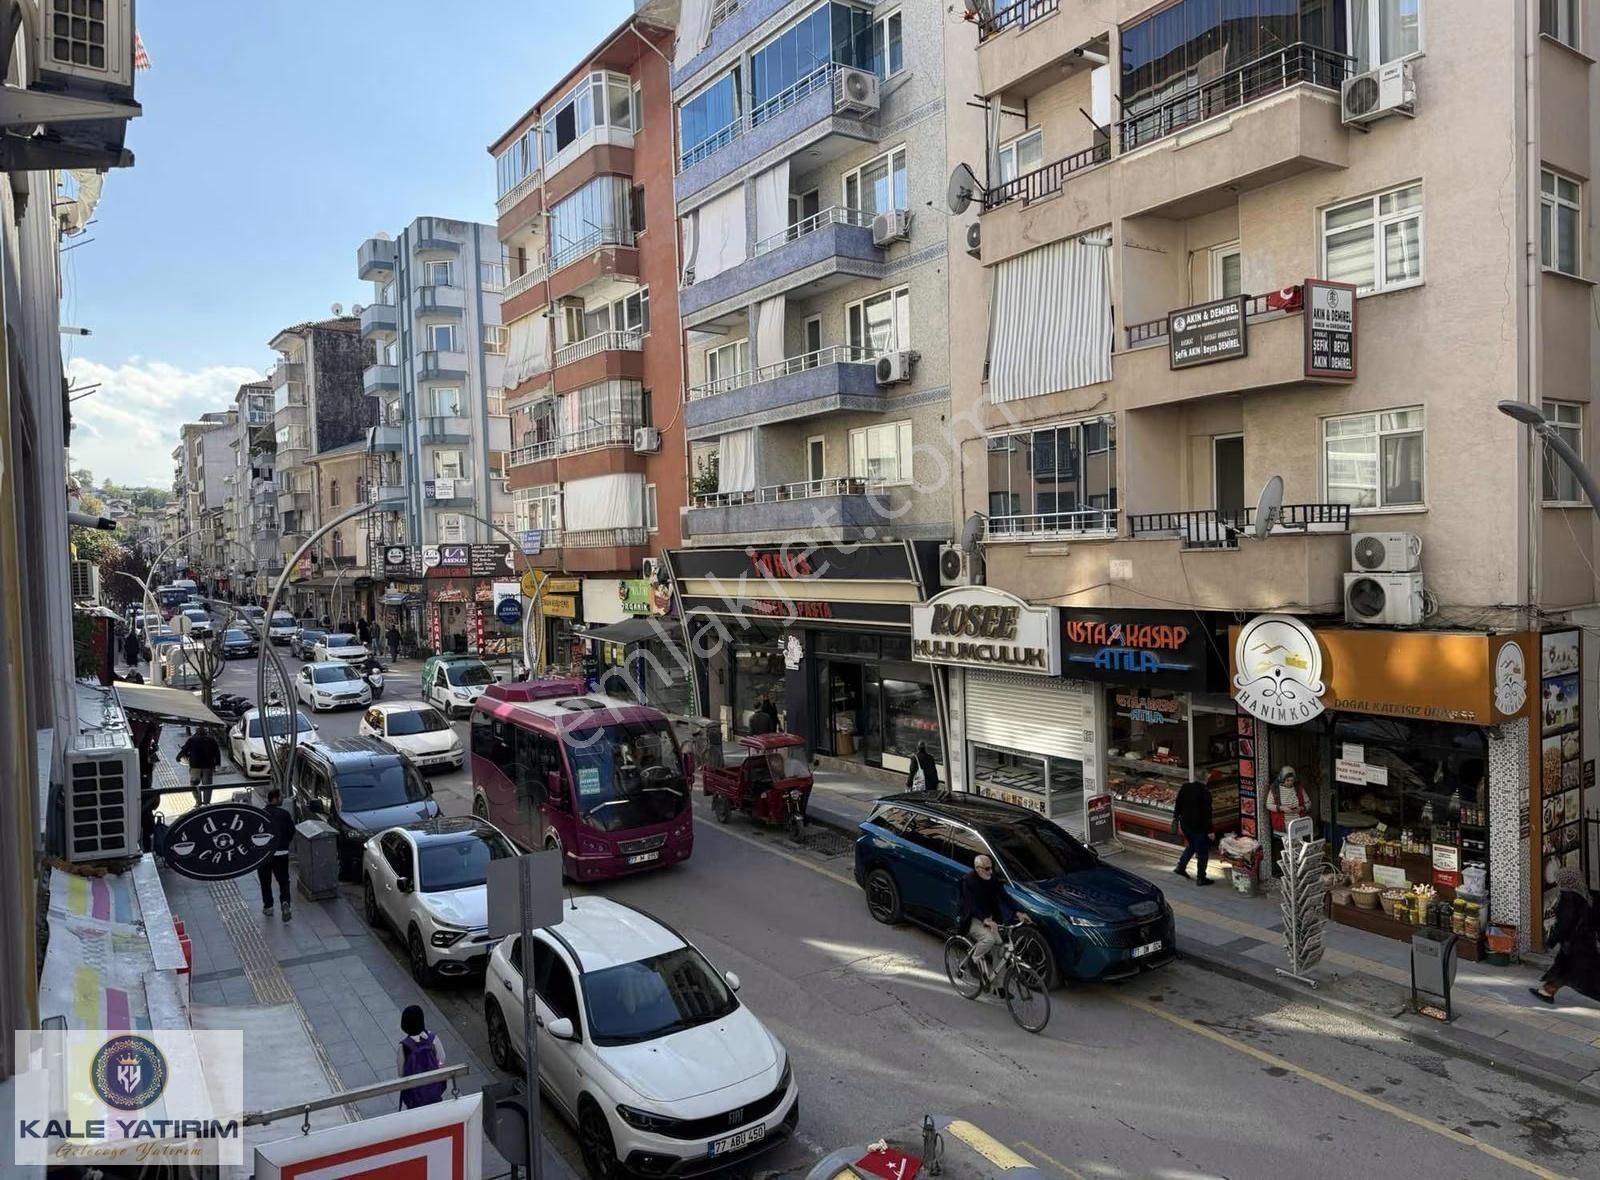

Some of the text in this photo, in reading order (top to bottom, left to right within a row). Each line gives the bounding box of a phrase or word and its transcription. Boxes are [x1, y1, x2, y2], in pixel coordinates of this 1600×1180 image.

[1186, 303, 1239, 325] AKIN & DEMİREL
[1313, 307, 1352, 323] AKIN & DEMİREL
[1188, 346, 1201, 357] AKIN
[1203, 337, 1240, 356] Beyza DEMİREL
[1333, 340, 1350, 353] BEYZA
[1313, 355, 1328, 368] AKIN
[1331, 356, 1352, 370] DEMİREL
[477, 609, 485, 654] KEBAP
[1066, 620, 1190, 650] USTA KASAP
[913, 639, 1046, 668] KUYUMCULUK
[1239, 690, 1320, 721] HANIMKÖY
[198, 843, 249, 864] CAFE
[728, 1108, 745, 1126] FIAT
[715, 1125, 764, 1153] 77 ABU 450
